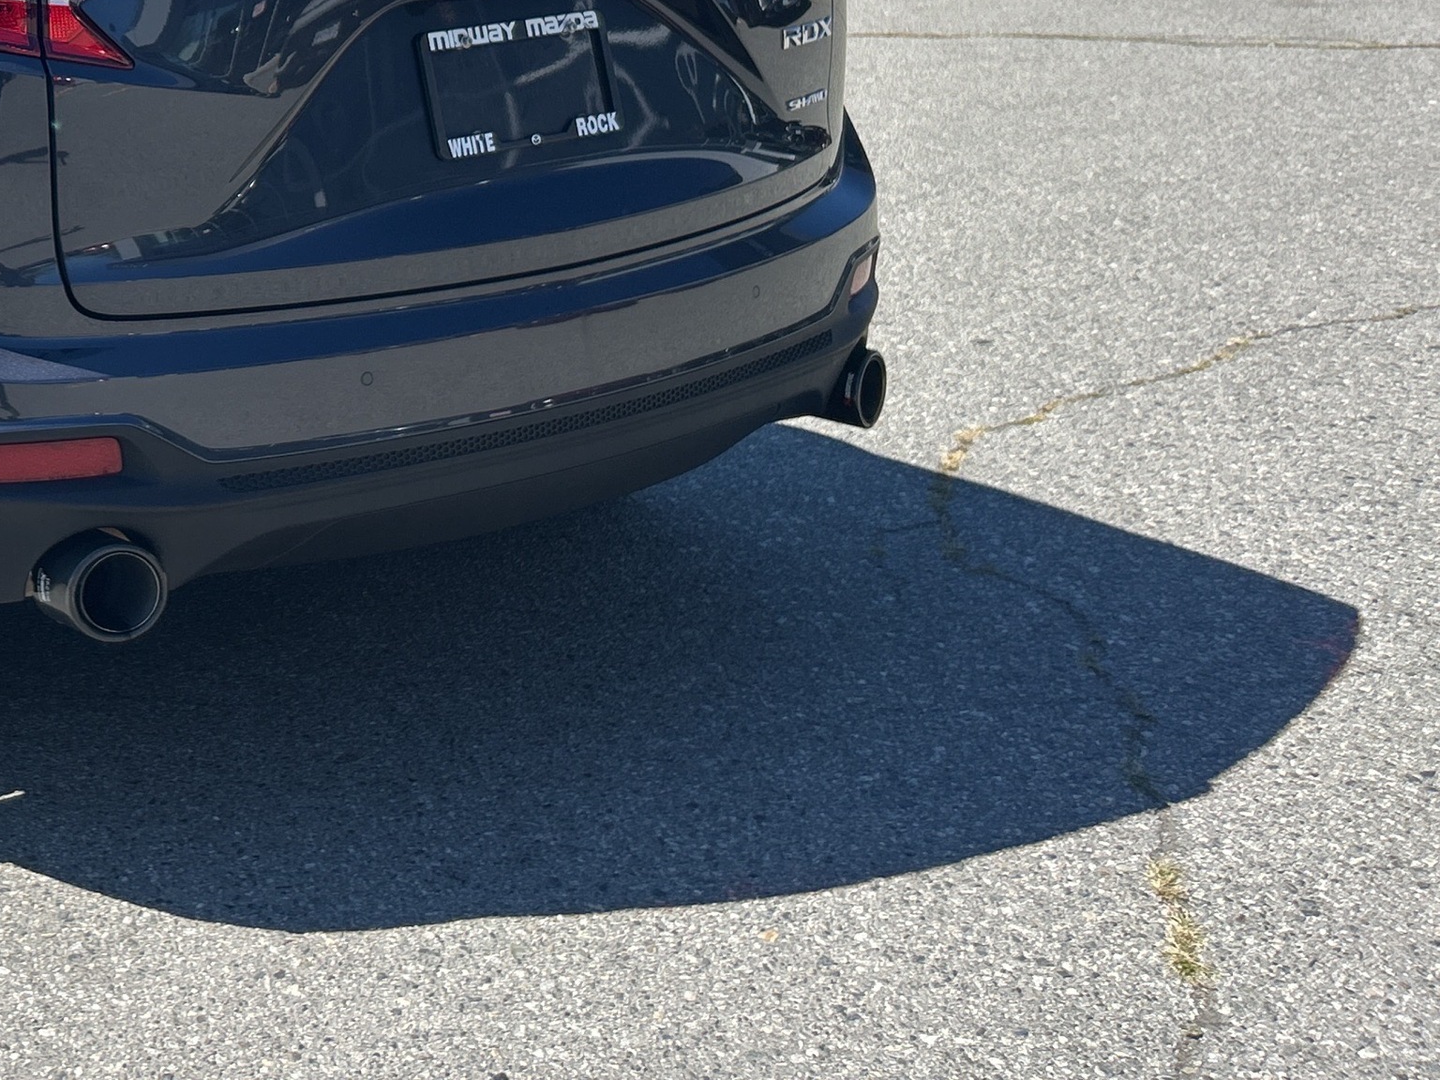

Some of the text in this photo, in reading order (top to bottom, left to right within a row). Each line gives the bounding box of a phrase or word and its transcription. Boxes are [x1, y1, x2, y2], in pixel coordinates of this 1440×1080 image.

[782, 16, 832, 50] RDX
[447, 111, 620, 159] WHITE ROCK
